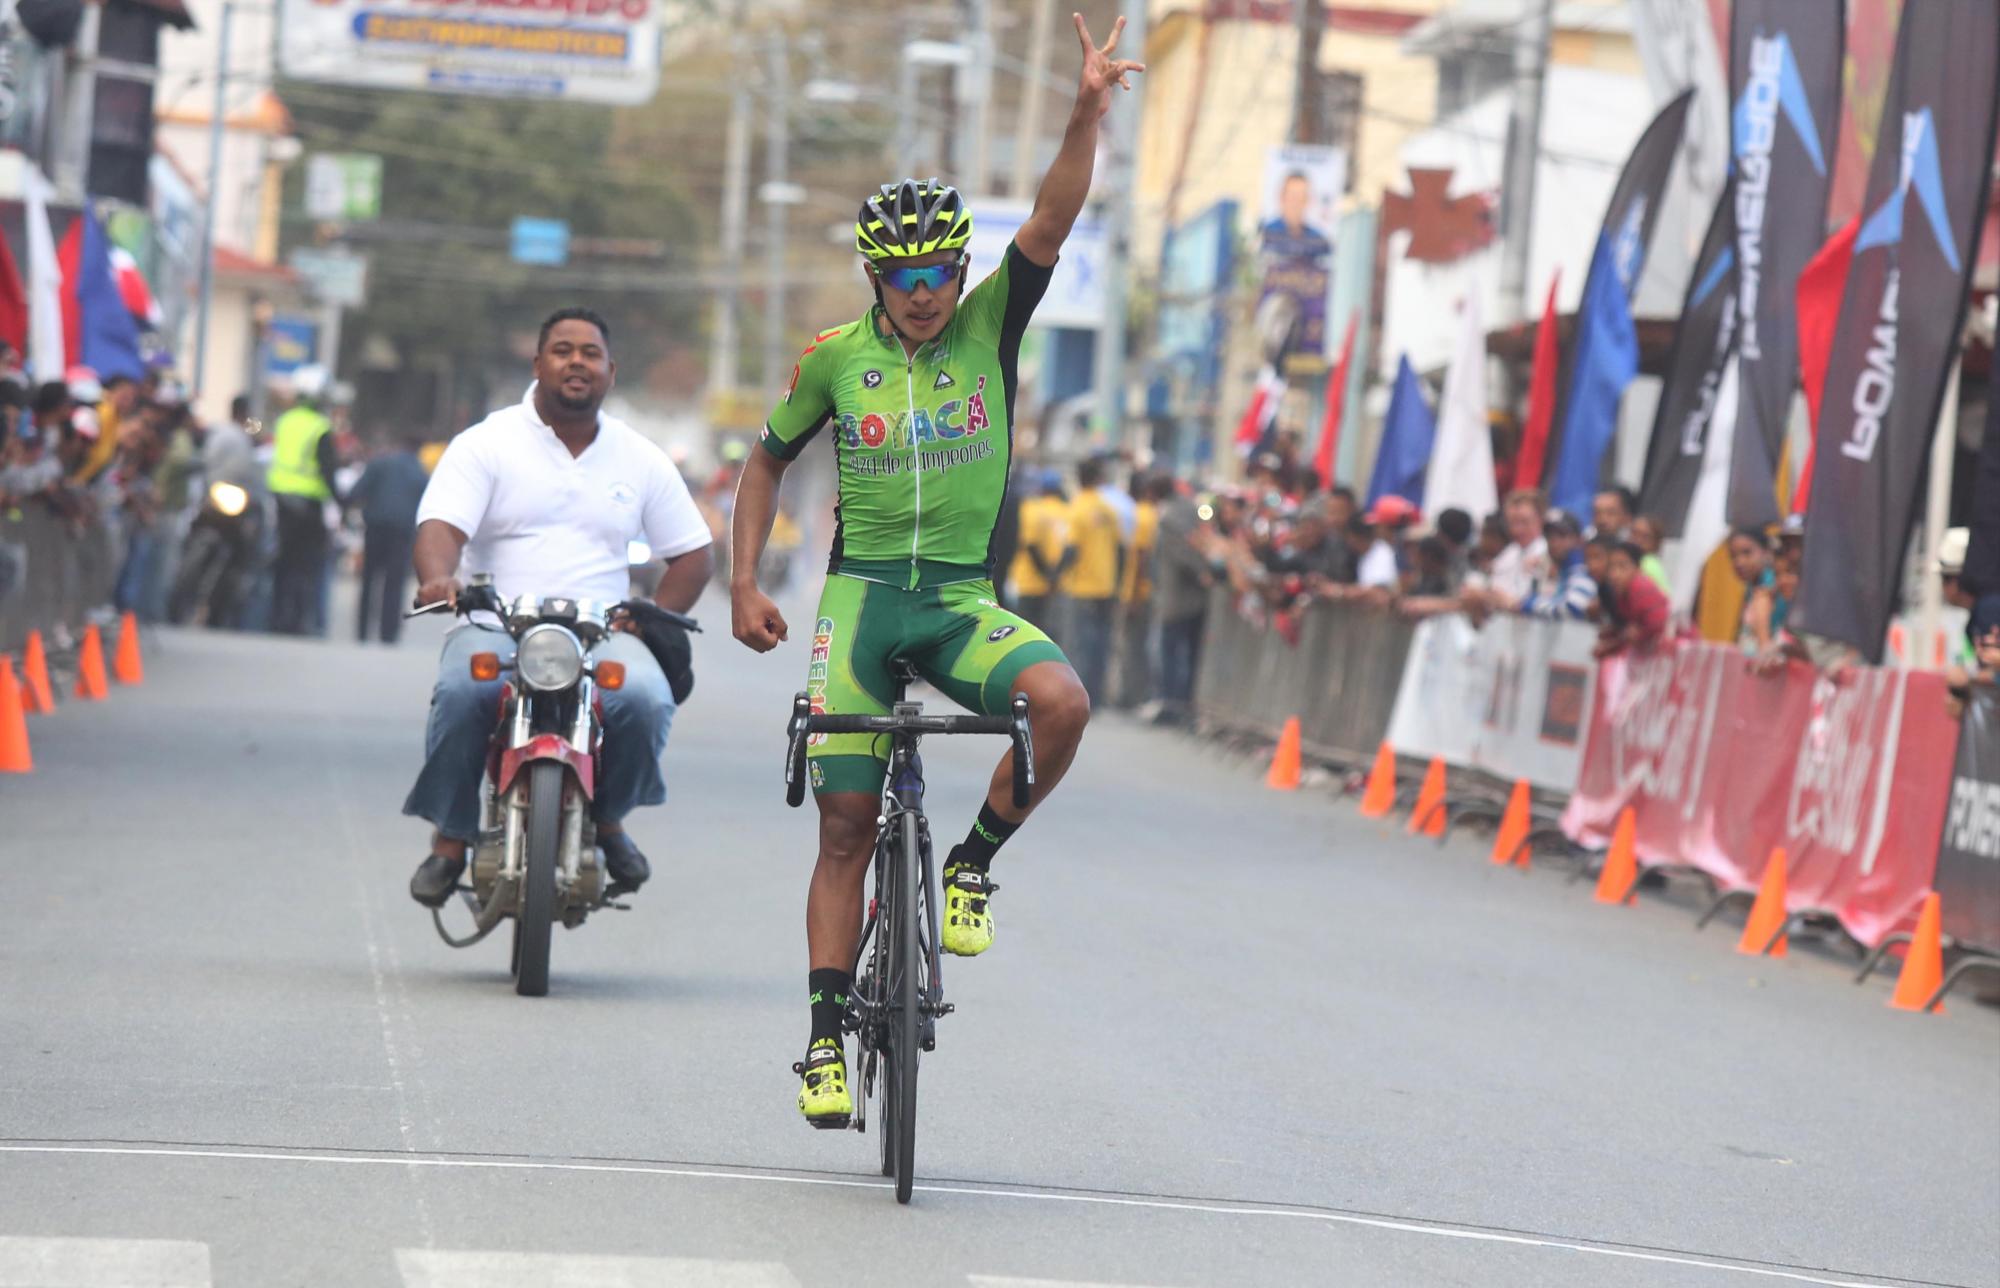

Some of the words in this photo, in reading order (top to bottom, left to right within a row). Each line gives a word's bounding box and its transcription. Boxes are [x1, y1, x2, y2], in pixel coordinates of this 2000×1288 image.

[840, 375, 991, 450] BOYACÁ
[881, 451, 901, 475] de
[956, 871, 983, 886] SIDI
[809, 1049, 836, 1062] SIDI
